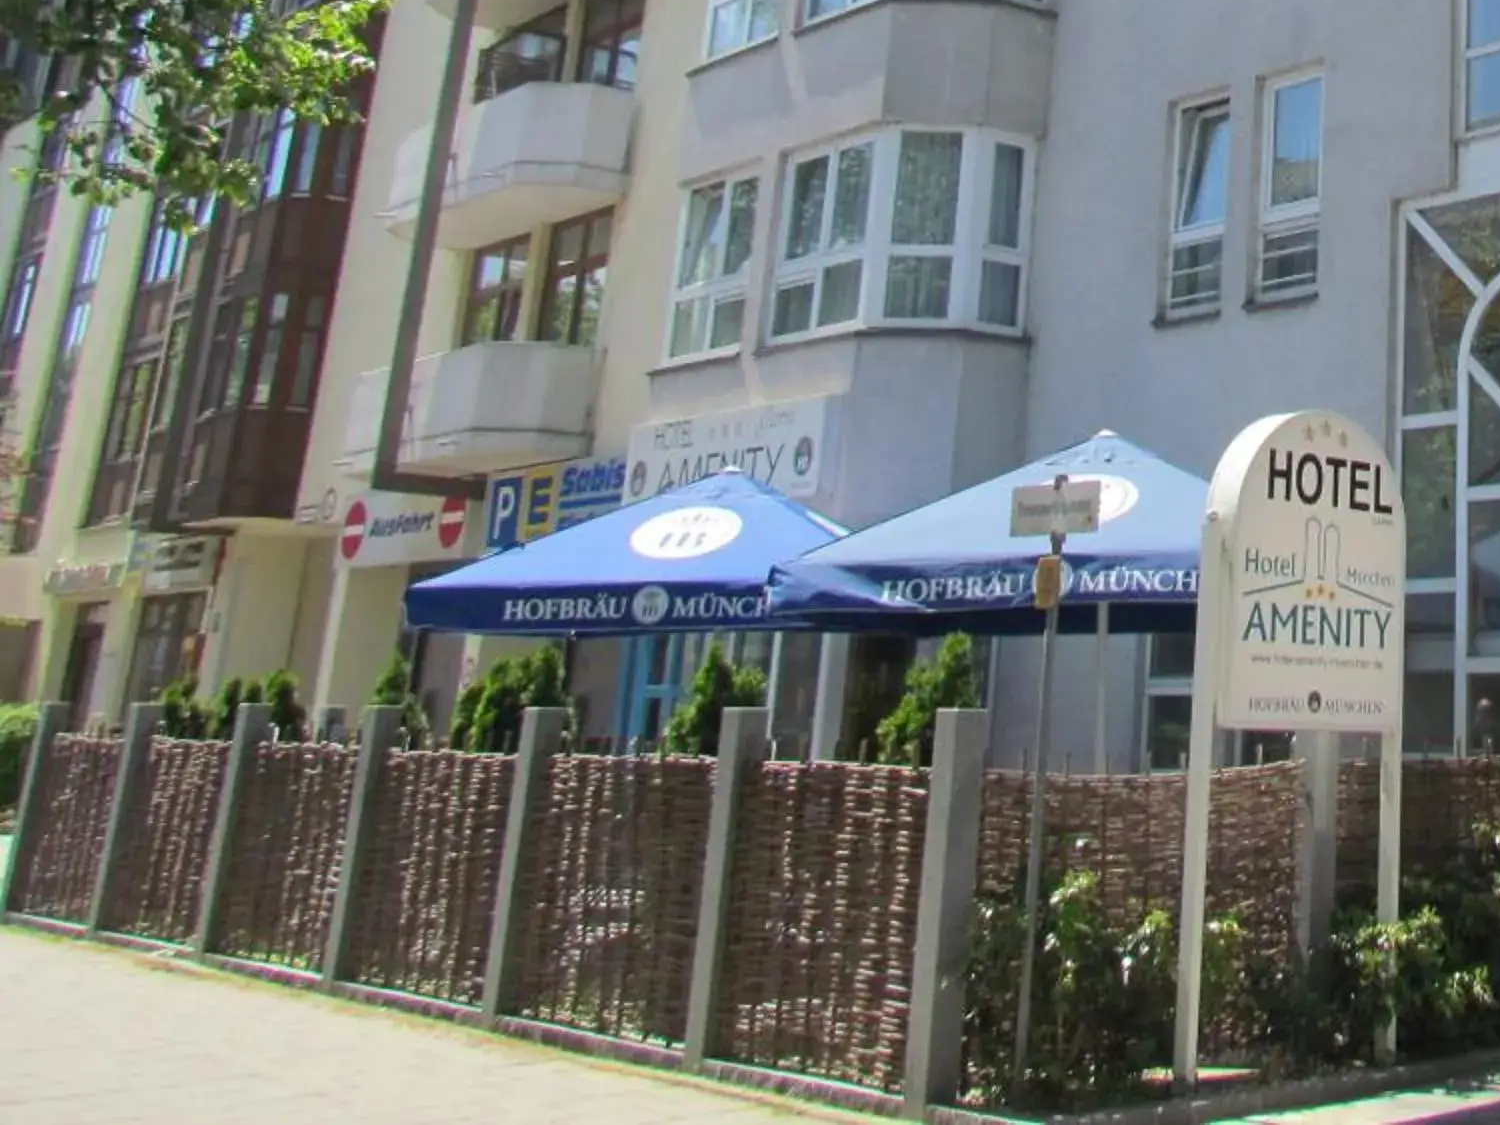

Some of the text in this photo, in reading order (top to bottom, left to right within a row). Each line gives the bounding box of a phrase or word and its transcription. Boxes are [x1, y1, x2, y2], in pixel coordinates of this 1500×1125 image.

[1267, 447, 1393, 516] HOTEL
[1245, 546, 1296, 578] Hotel
[880, 571, 1025, 603] HOFBRÄU
[502, 592, 628, 622] HOFBRÄU
[1241, 600, 1393, 650] AMENITY
